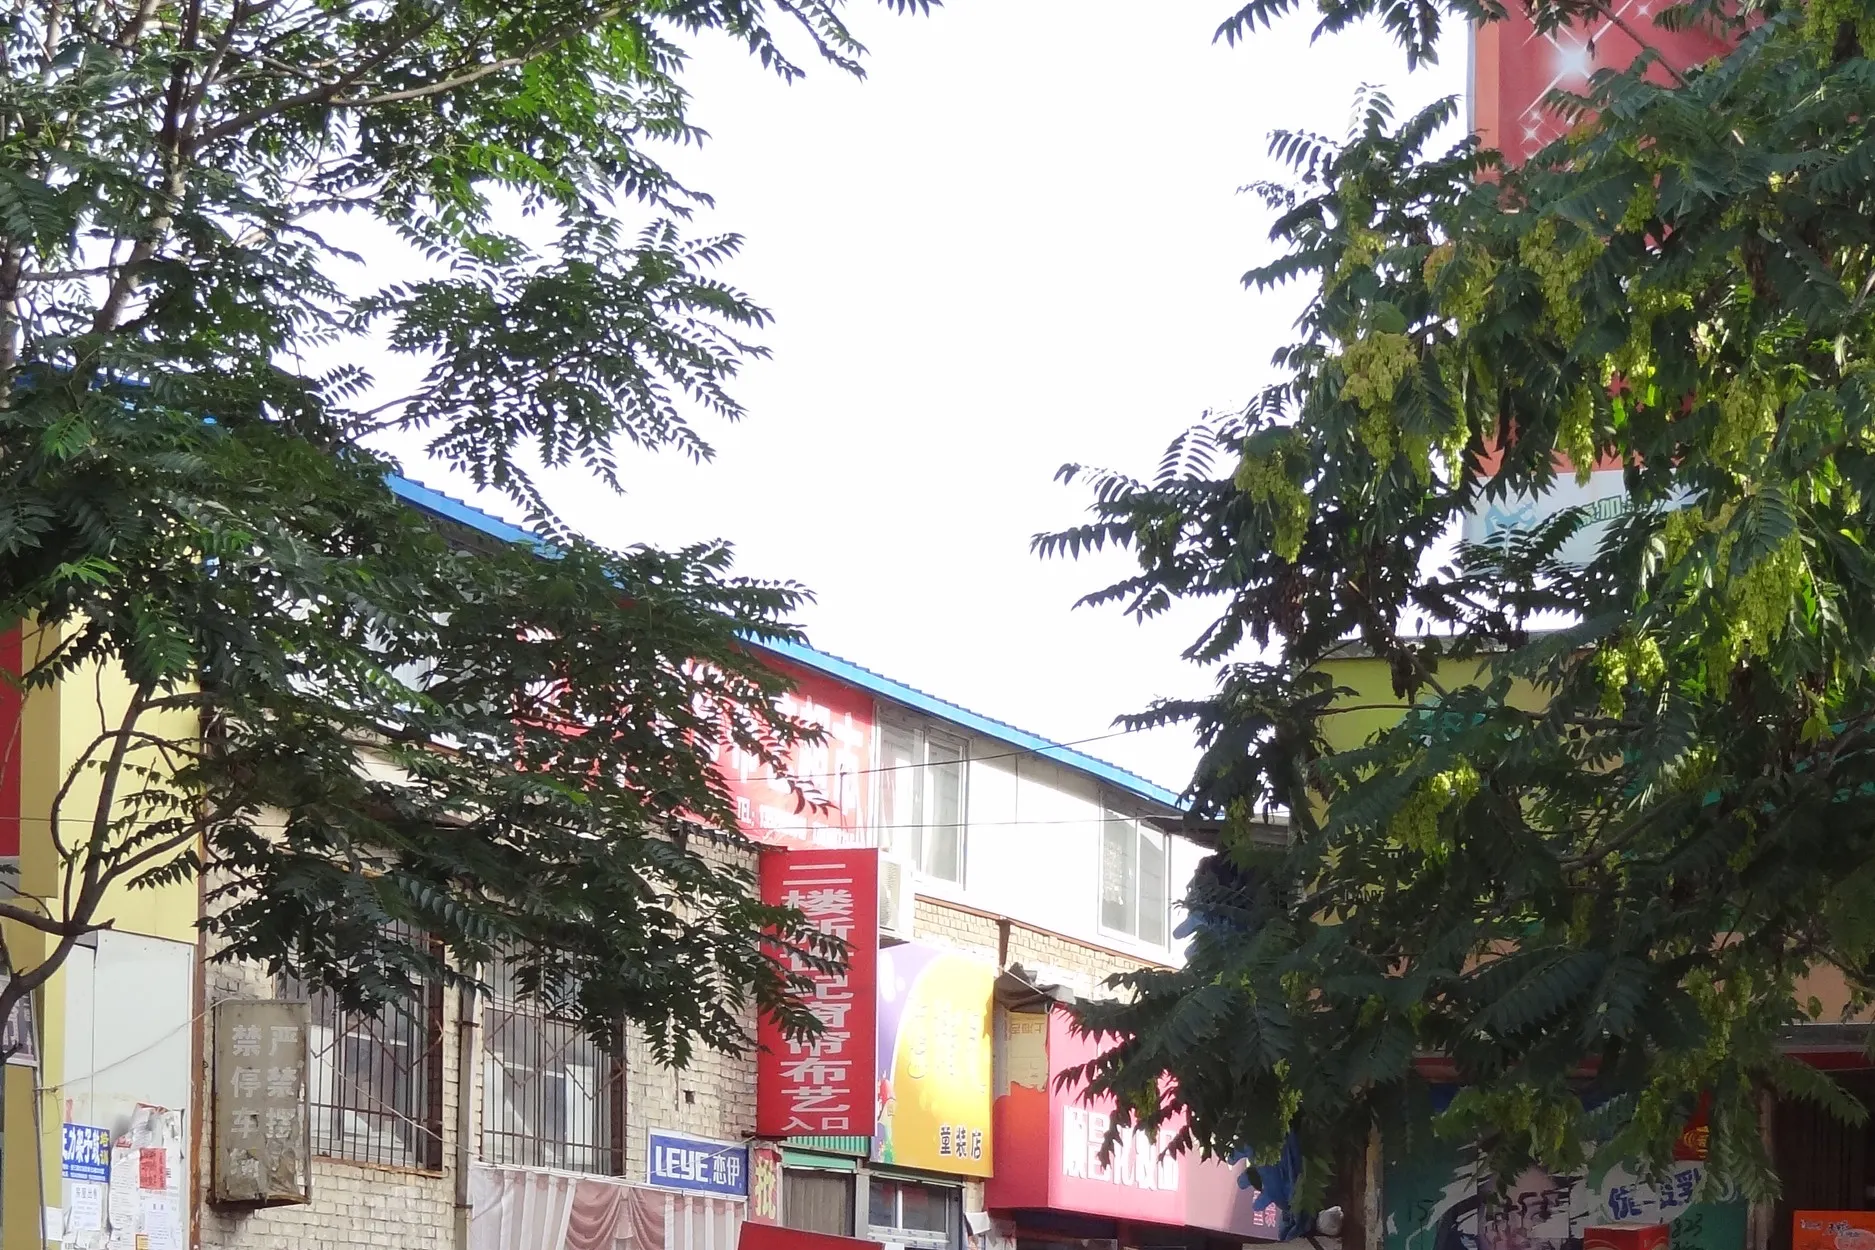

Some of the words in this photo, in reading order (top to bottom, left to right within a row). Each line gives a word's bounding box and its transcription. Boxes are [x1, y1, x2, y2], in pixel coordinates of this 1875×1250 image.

[781, 1115, 849, 1132] 入口
[940, 1125, 982, 1160] 童装店
[655, 1146, 709, 1183] LEYE
